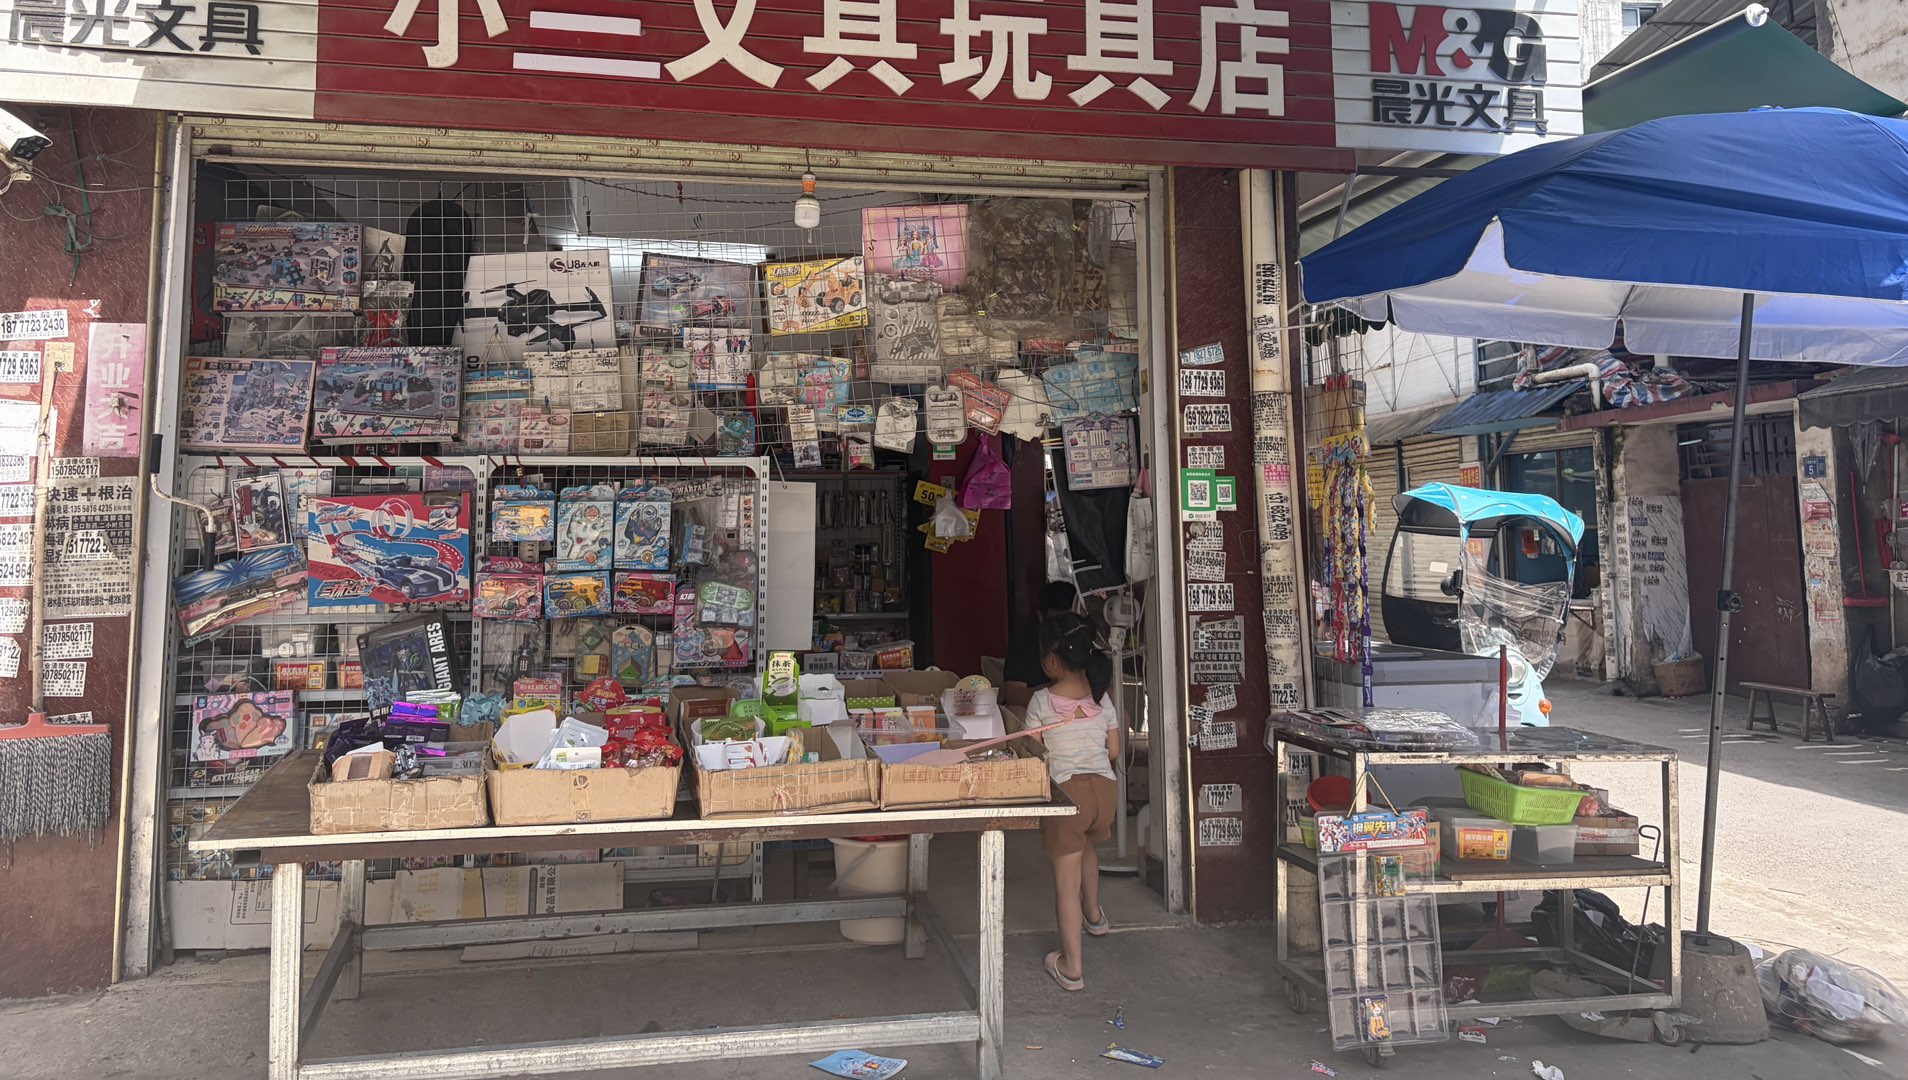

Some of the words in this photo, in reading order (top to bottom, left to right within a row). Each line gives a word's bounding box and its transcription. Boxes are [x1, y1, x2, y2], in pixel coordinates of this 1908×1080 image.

[1369, 1, 1548, 83] M&G
[1372, 79, 1549, 134] 晨光文具
[2, 321, 17, 334] 187
[20, 320, 41, 333] 7723
[43, 318, 65, 331] 2430
[0, 358, 17, 375] 729
[20, 359, 39, 375] 9363
[1181, 375, 1192, 390] 158
[1193, 375, 1208, 390] 7729
[1209, 376, 1224, 391] 9363
[1186, 411, 1196, 425] 159
[1197, 411, 1213, 425] 7822
[1213, 410, 1229, 425] 7252
[52, 465, 99, 476] 15078502117
[1189, 590, 1200, 605] 158
[1201, 590, 1216, 605] 7729
[1218, 590, 1233, 605] 9363
[45, 631, 92, 643] 15078502117
[427, 622, 446, 652] ARES
[771, 660, 791, 668] 抹茶
[433, 656, 452, 690] GIANT
[1201, 825, 1210, 838] 158
[1212, 825, 1225, 838] 7729
[1226, 824, 1240, 838] 9363
